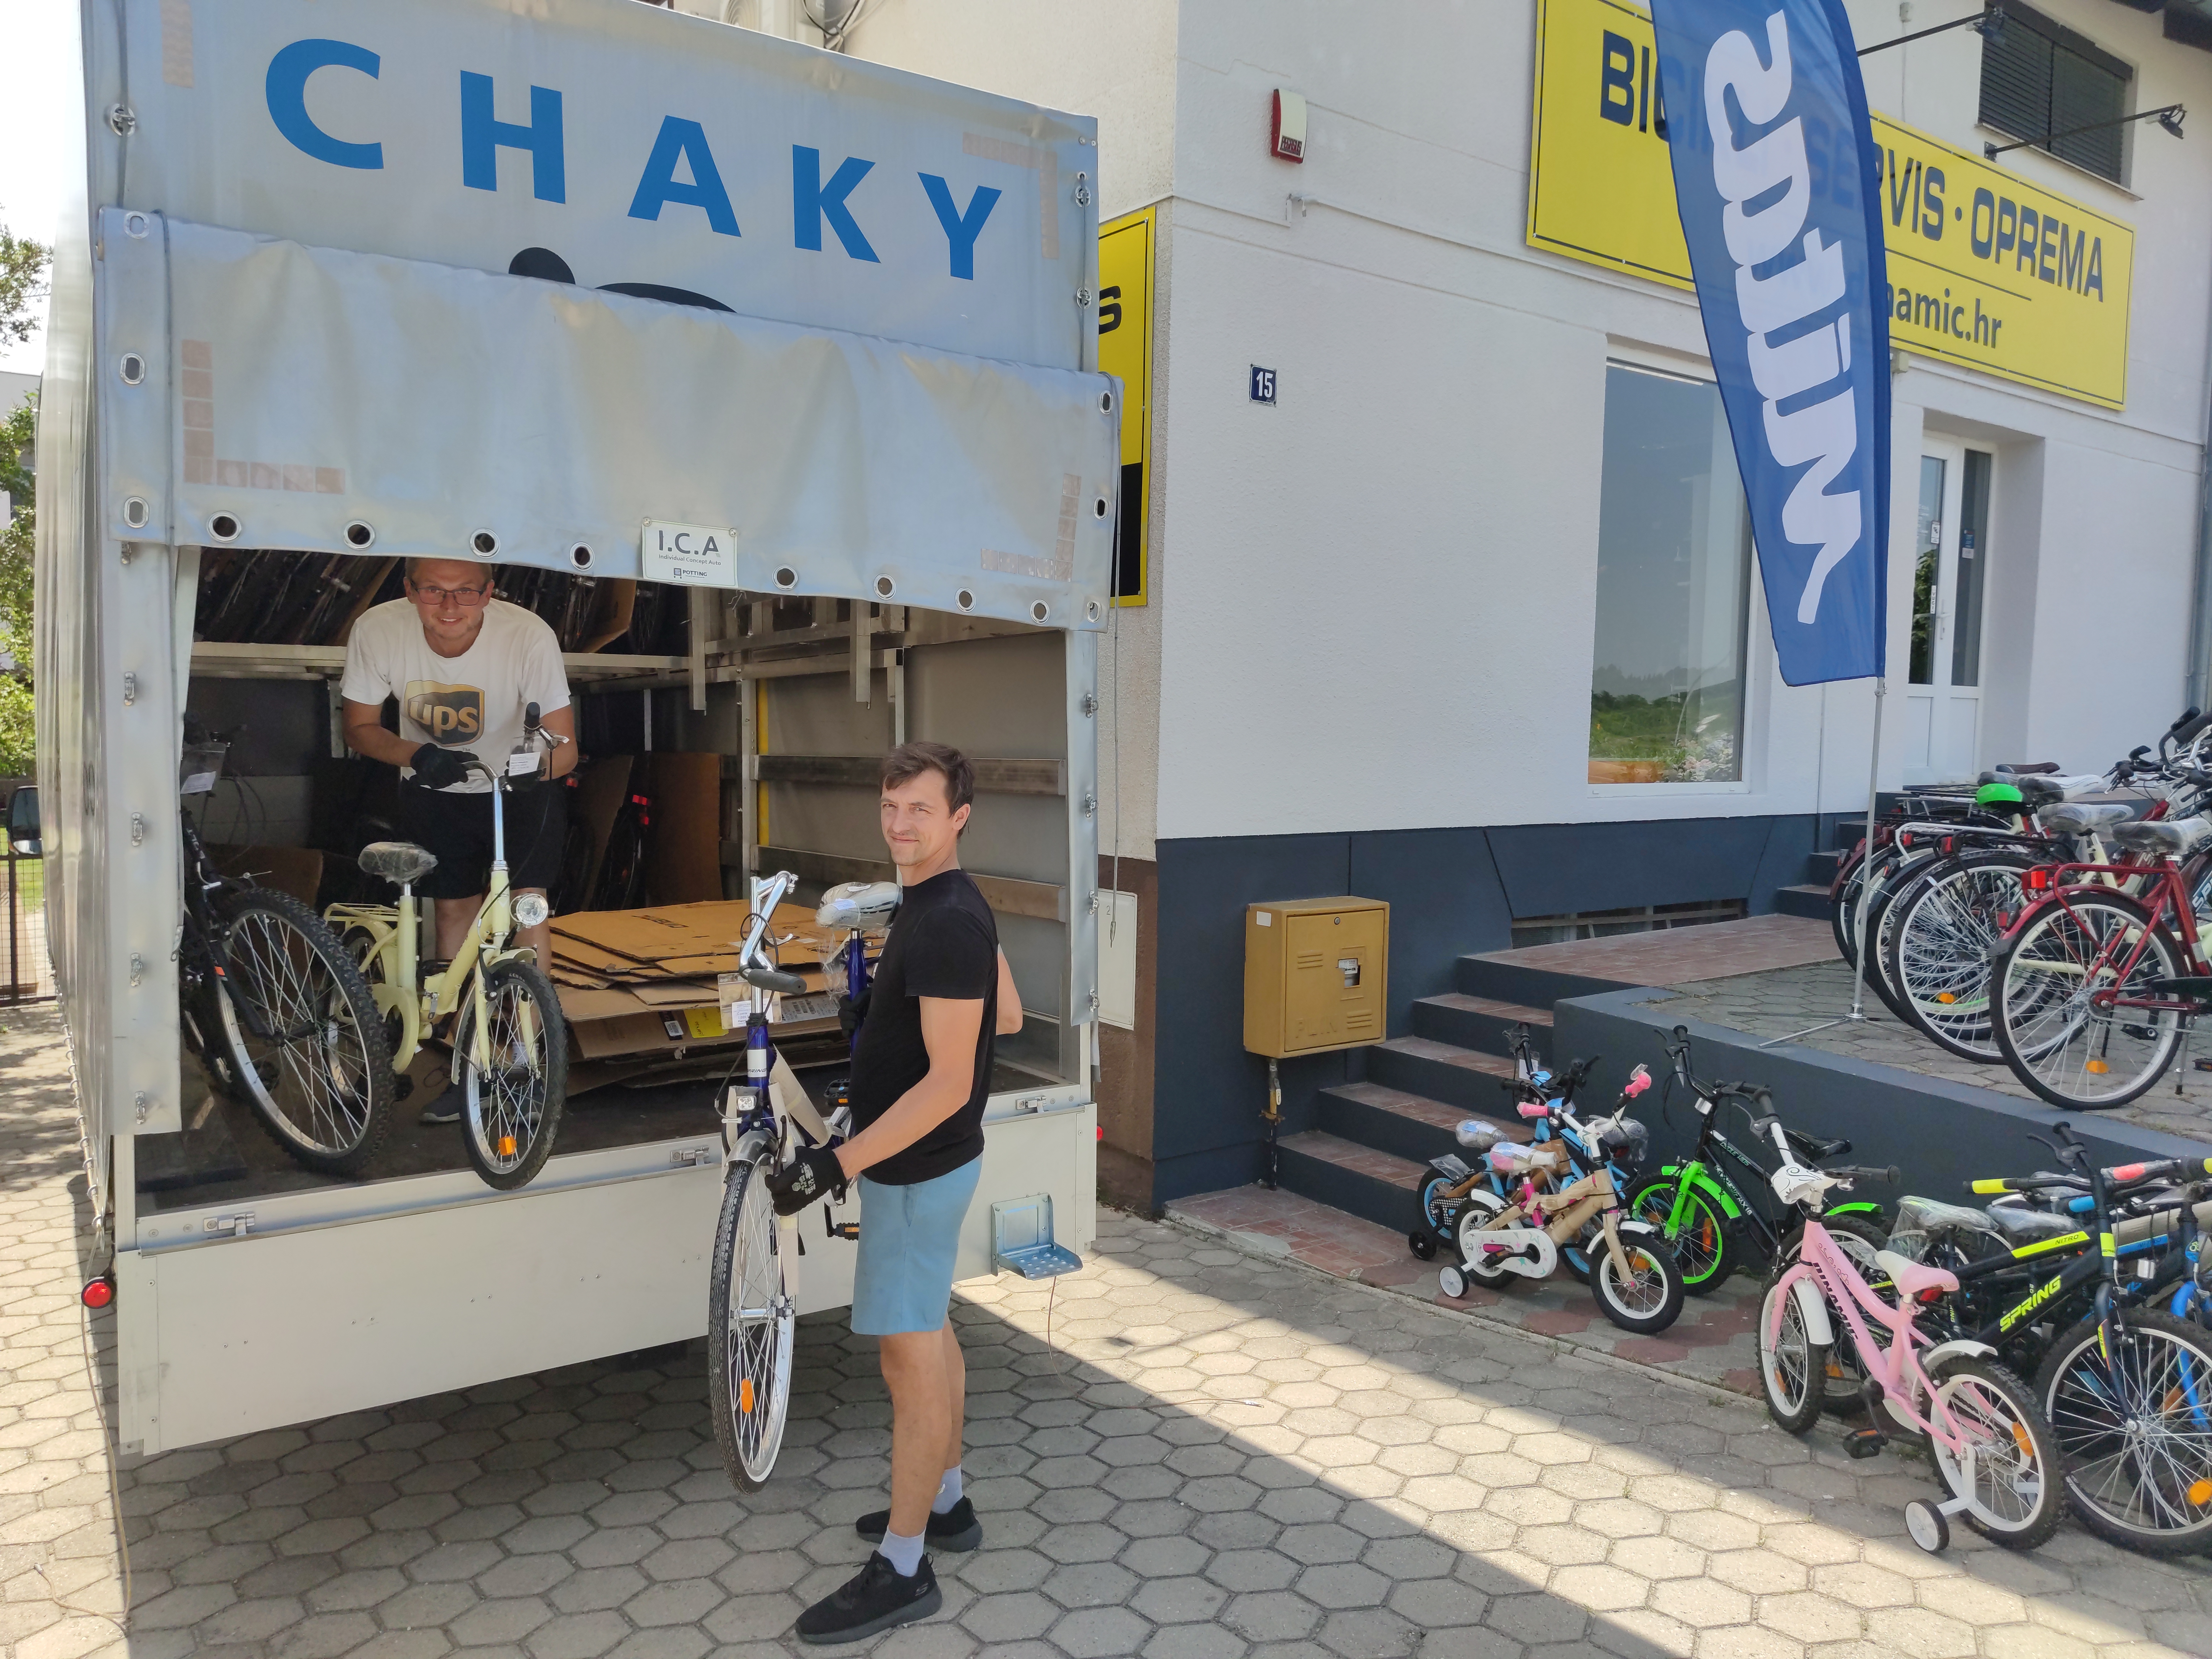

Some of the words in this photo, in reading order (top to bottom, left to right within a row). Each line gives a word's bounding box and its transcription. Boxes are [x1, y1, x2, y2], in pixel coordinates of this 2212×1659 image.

[265, 38, 1002, 281] CHAKY
[1970, 186, 2104, 303] OPREMA
[1256, 371, 1273, 398] 15
[658, 530, 719, 556] I.C.A
[1106, 905, 1111, 915] 2
[2055, 1234, 2079, 1245] NITRO
[2000, 1274, 2062, 1332] SPRING
